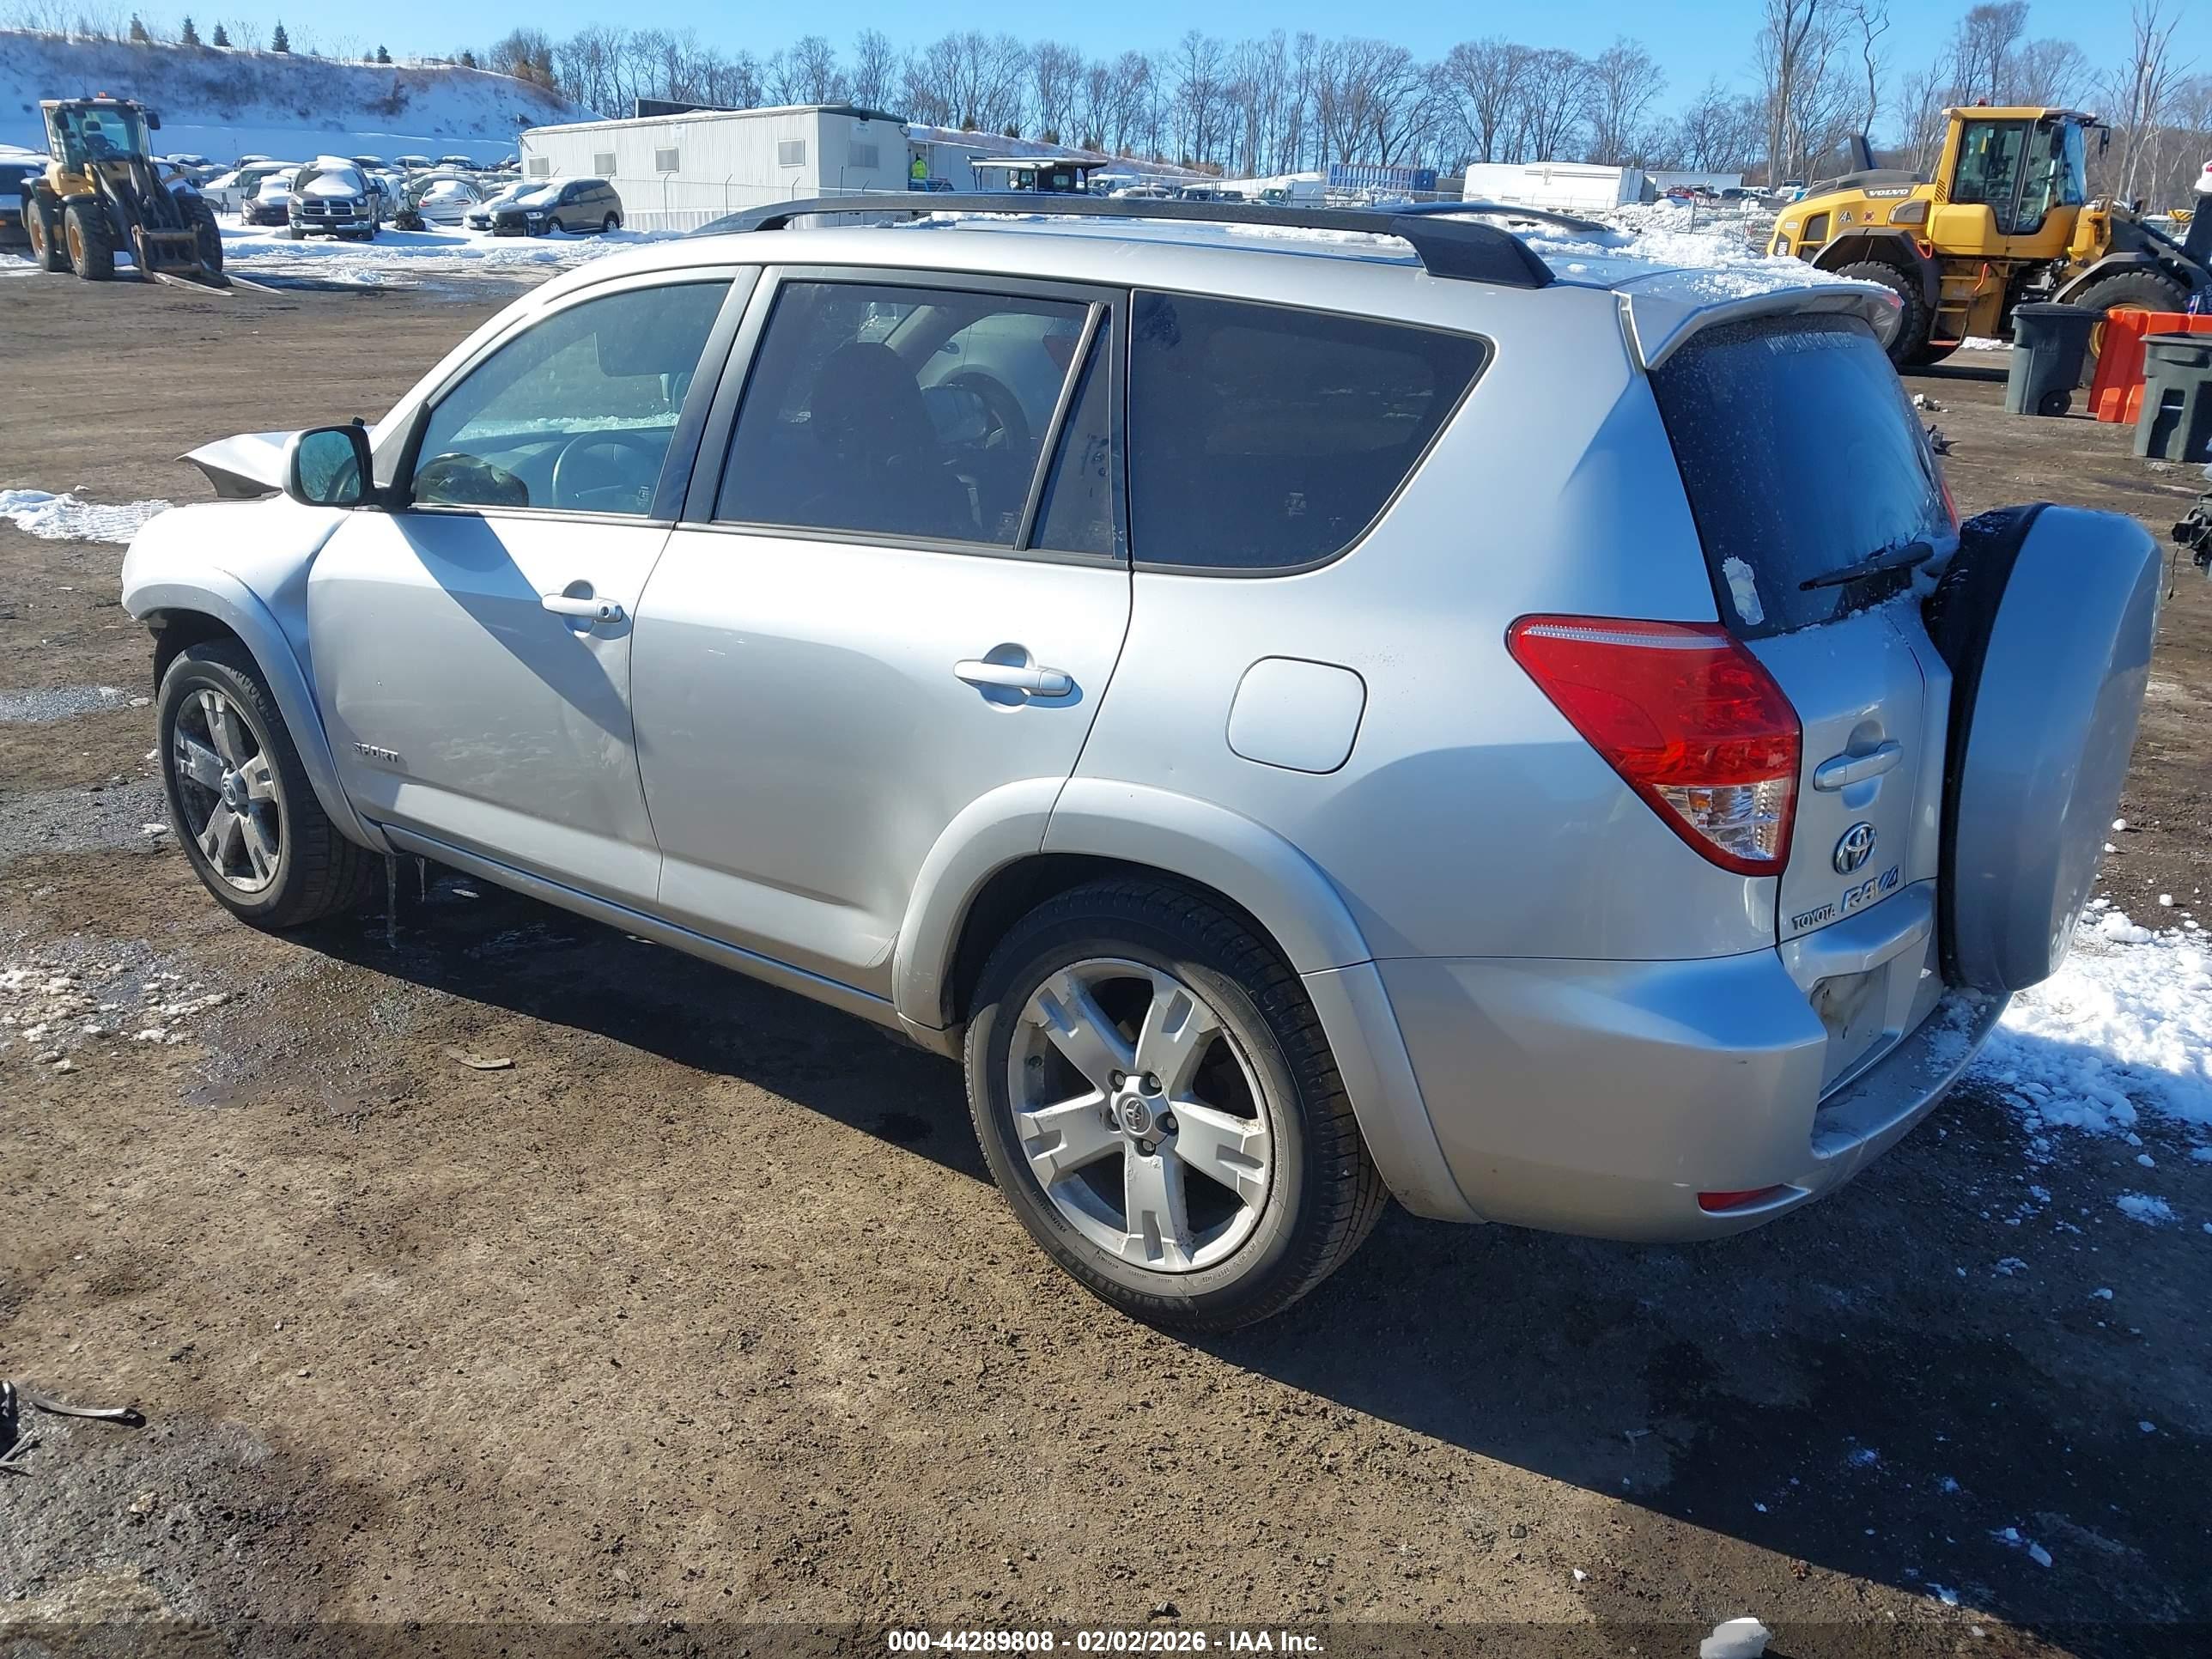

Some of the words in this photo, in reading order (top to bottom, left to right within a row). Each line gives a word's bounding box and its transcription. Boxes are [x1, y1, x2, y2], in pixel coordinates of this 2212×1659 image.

[1869, 188, 1909, 197] VOLVO
[350, 741, 399, 763] SPORT
[1791, 903, 1836, 930] TOYOTA
[1840, 865, 1899, 913] RAV4
